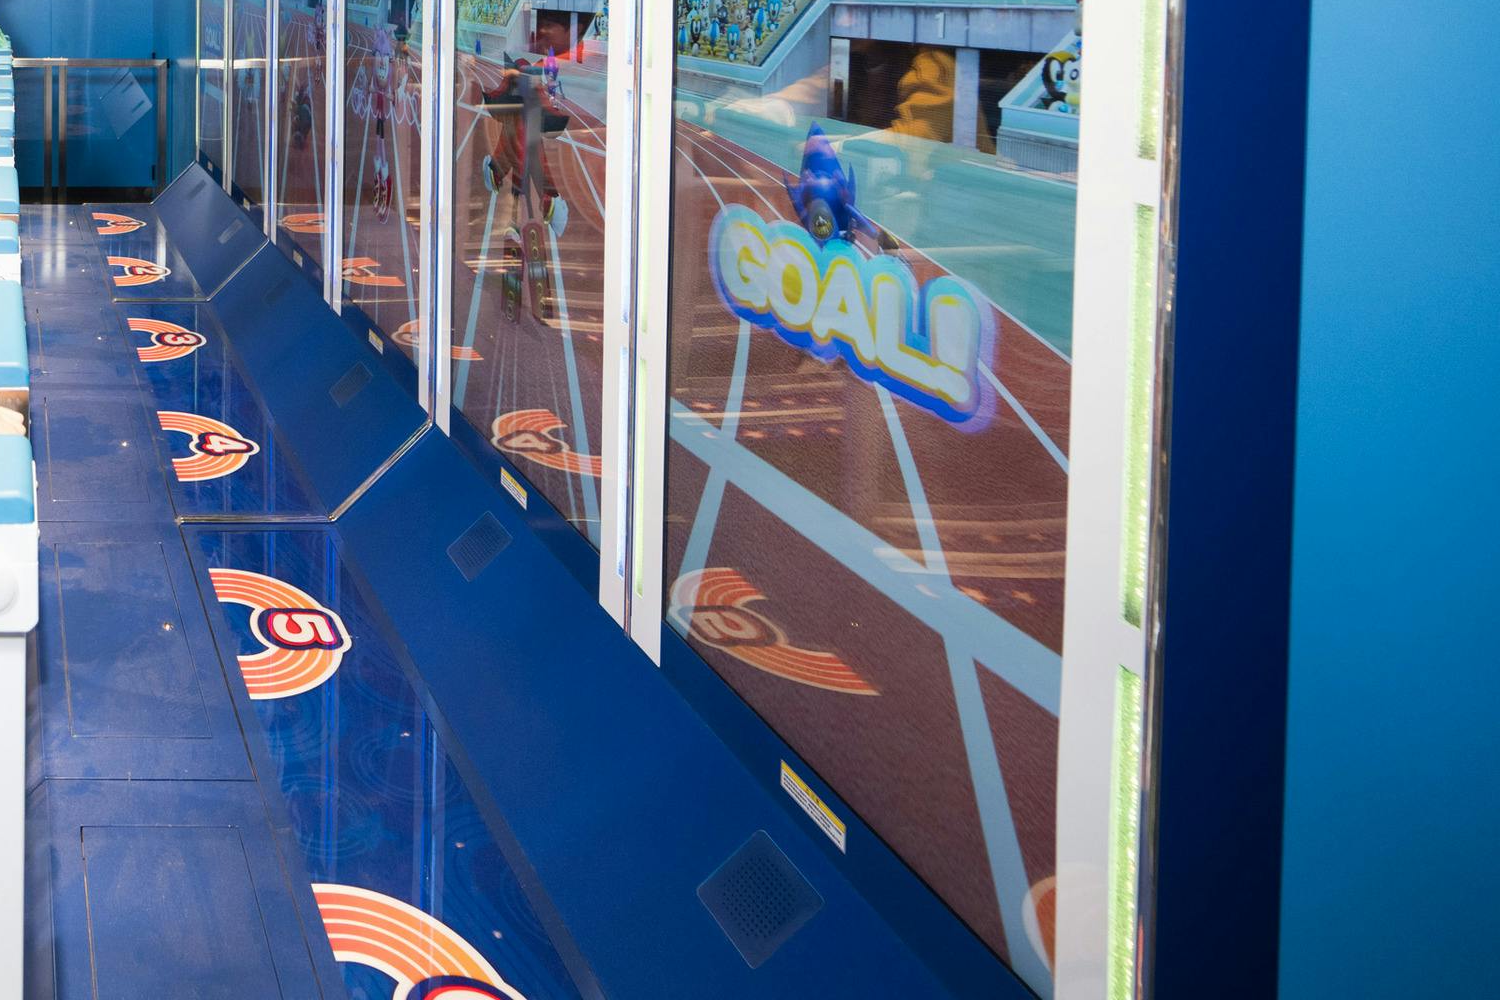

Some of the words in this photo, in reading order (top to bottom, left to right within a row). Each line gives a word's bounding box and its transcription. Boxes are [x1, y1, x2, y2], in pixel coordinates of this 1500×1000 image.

[721, 225, 980, 408] GOAL!
[163, 332, 197, 345] 3
[205, 432, 250, 454] 4
[271, 612, 336, 644] 5
